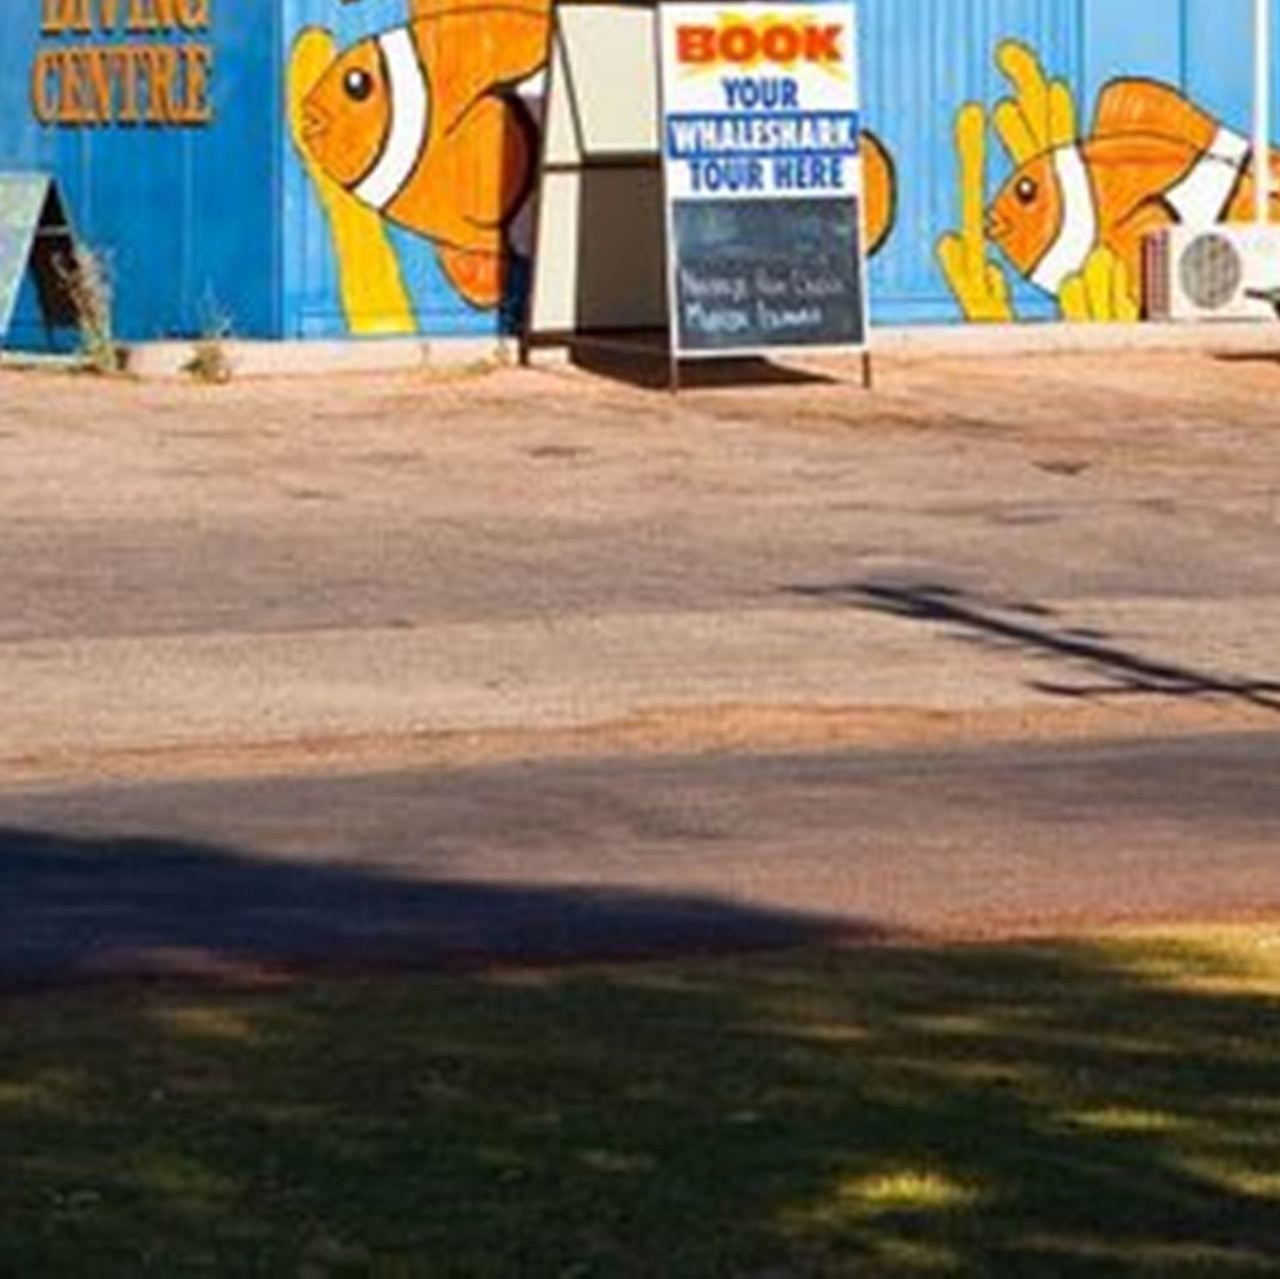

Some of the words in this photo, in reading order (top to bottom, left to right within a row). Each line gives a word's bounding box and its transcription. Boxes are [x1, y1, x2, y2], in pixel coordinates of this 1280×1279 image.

[677, 24, 843, 64] BOOK
[30, 43, 212, 127] CENTRE
[721, 76, 799, 108] YOUR
[671, 117, 856, 153] WHALESHARK
[689, 157, 765, 192] TOUR
[774, 155, 844, 189] HERE
